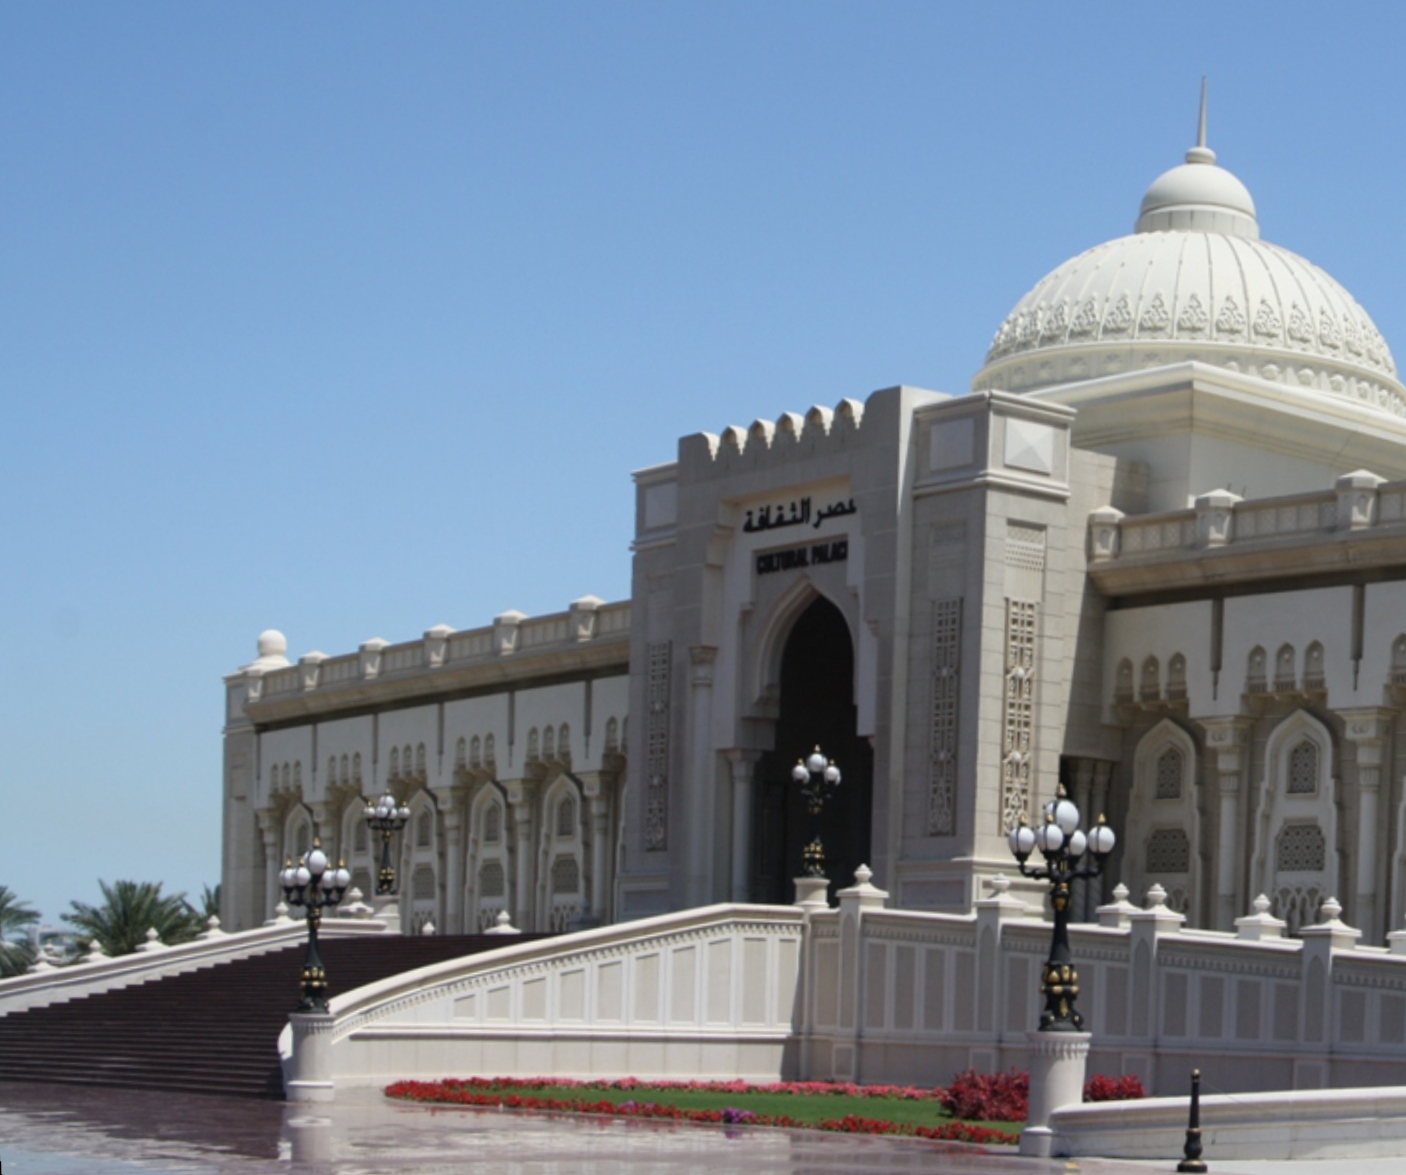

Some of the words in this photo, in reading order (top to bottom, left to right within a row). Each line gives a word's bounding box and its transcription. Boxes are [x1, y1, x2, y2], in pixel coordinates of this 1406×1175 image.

[743, 496, 811, 533] الثقافة
[756, 547, 809, 575] CULTURAL
[811, 540, 848, 565] PALAC
